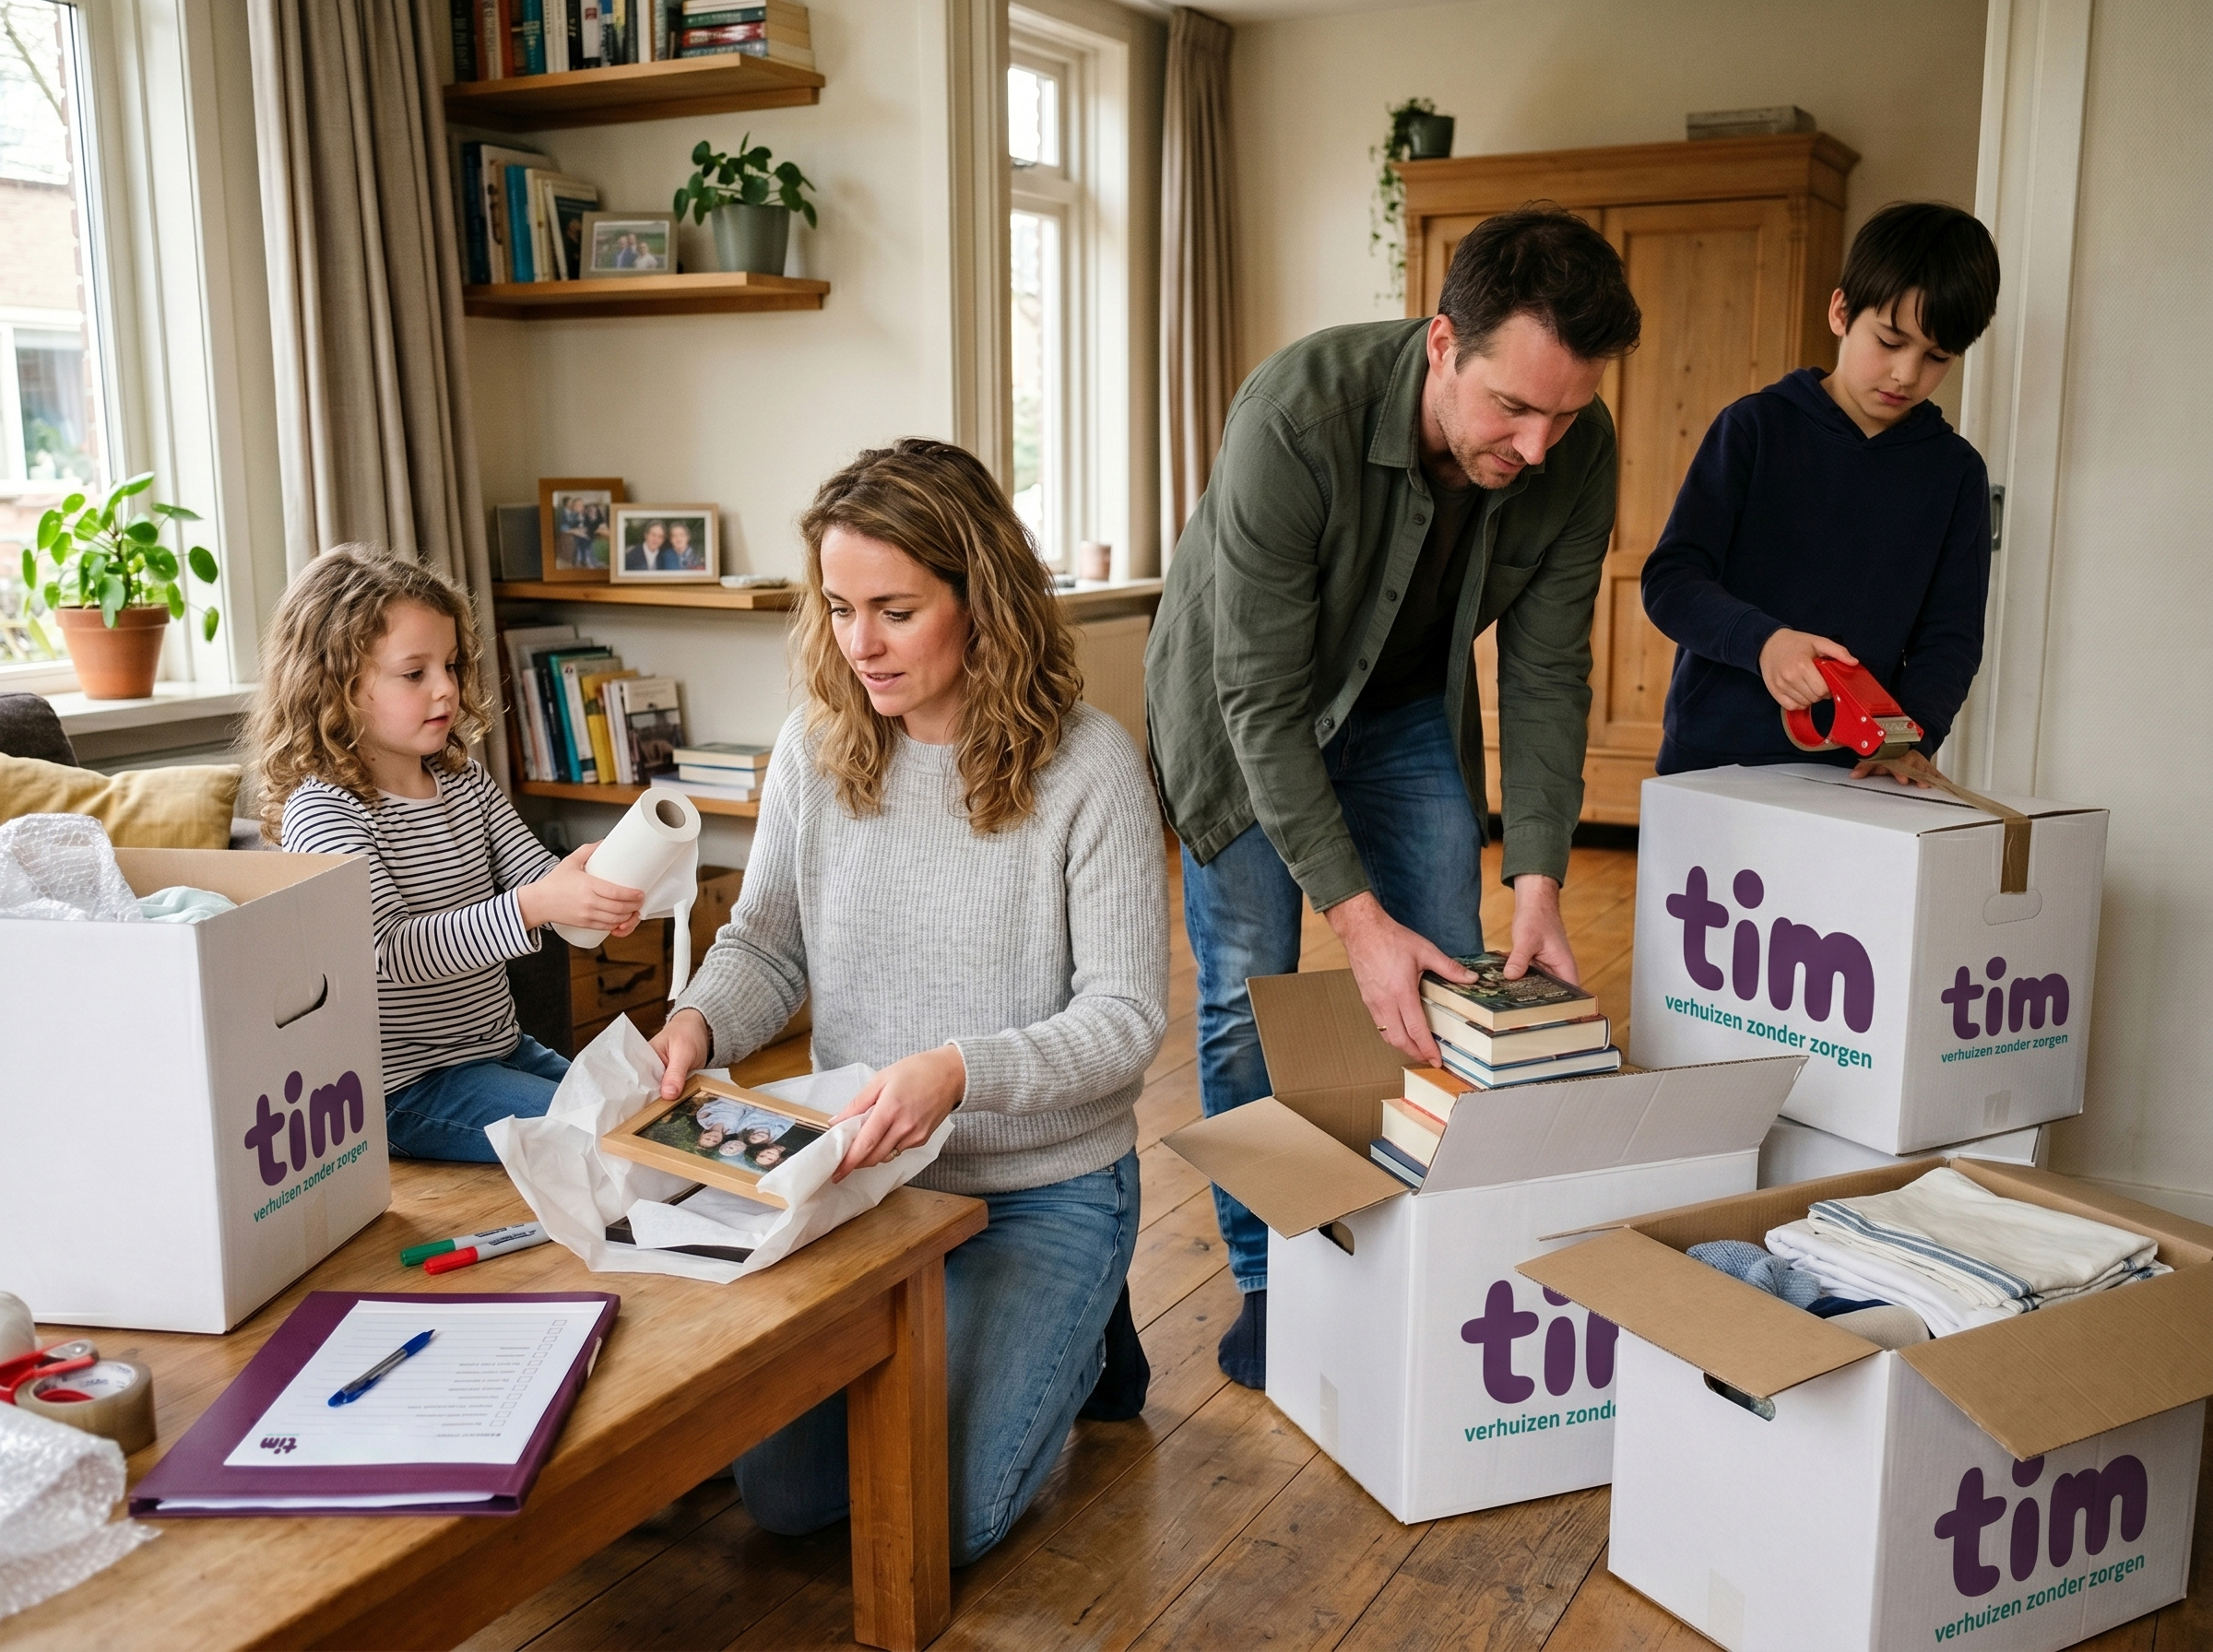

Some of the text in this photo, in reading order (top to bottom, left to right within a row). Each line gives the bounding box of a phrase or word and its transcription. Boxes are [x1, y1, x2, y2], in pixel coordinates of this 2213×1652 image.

[1665, 865, 1875, 1033] tim
[1665, 995, 1873, 1069] verhuizen zonder zorgen
[1941, 956, 2070, 1040] tim
[1941, 1032, 2068, 1063] verhuizen zonder zorgen
[244, 1070, 364, 1186] tim
[254, 1140, 368, 1222] verhuizen zonder zorgen
[260, 1437, 297, 1454] tim
[1464, 1400, 1616, 1442] verhuizen zond
[1934, 1455, 2148, 1597] tim
[1935, 1554, 2145, 1643] verhuizen zonder zorgen
